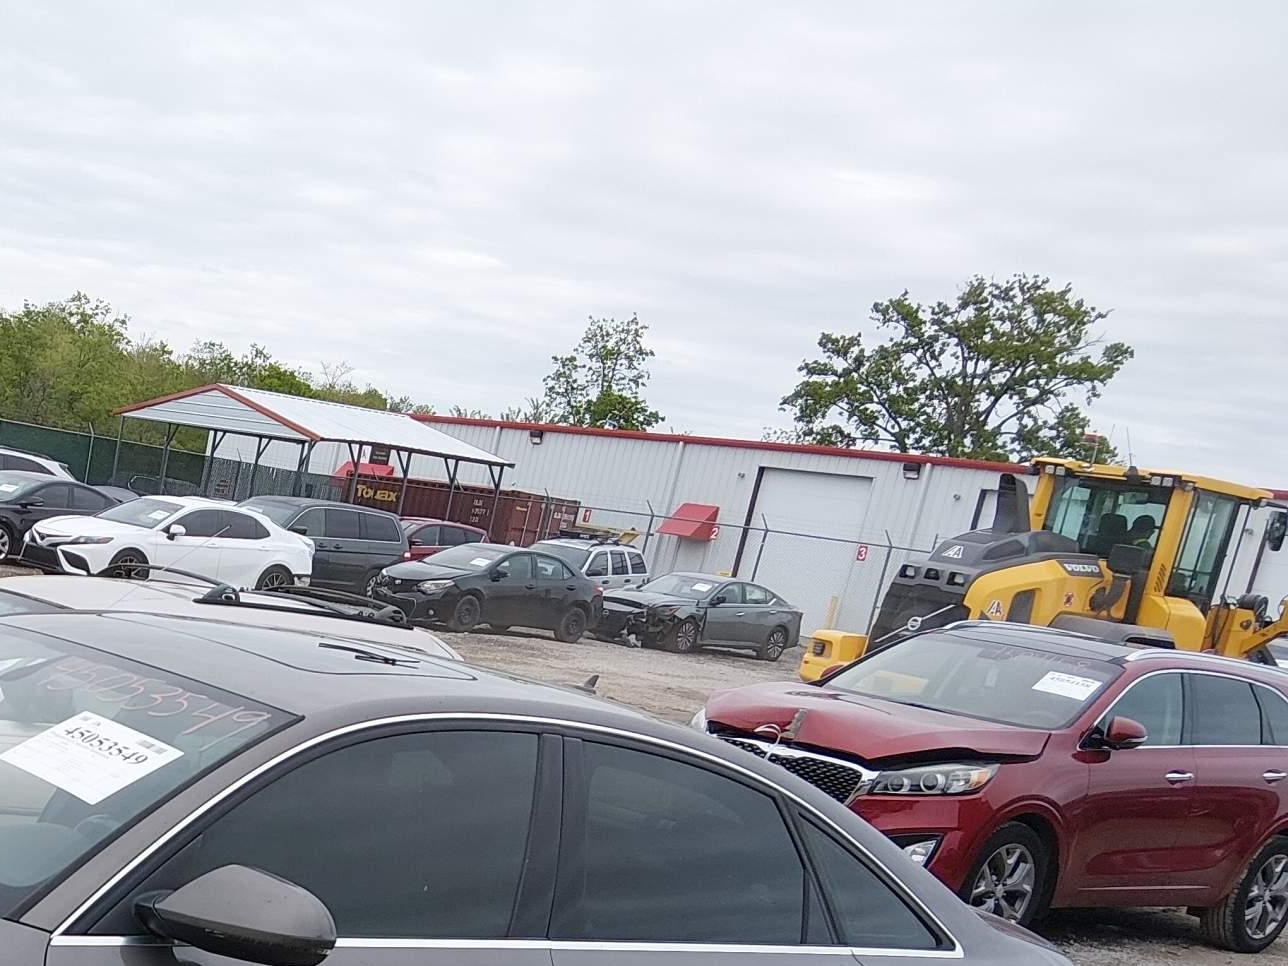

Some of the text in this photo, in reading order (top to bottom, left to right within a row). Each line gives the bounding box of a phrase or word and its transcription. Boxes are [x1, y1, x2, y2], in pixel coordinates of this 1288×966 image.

[710, 527, 719, 539] 2
[858, 547, 866, 560] 3
[1063, 563, 1100, 574] VOLVO
[64, 726, 149, 765] 45053549
